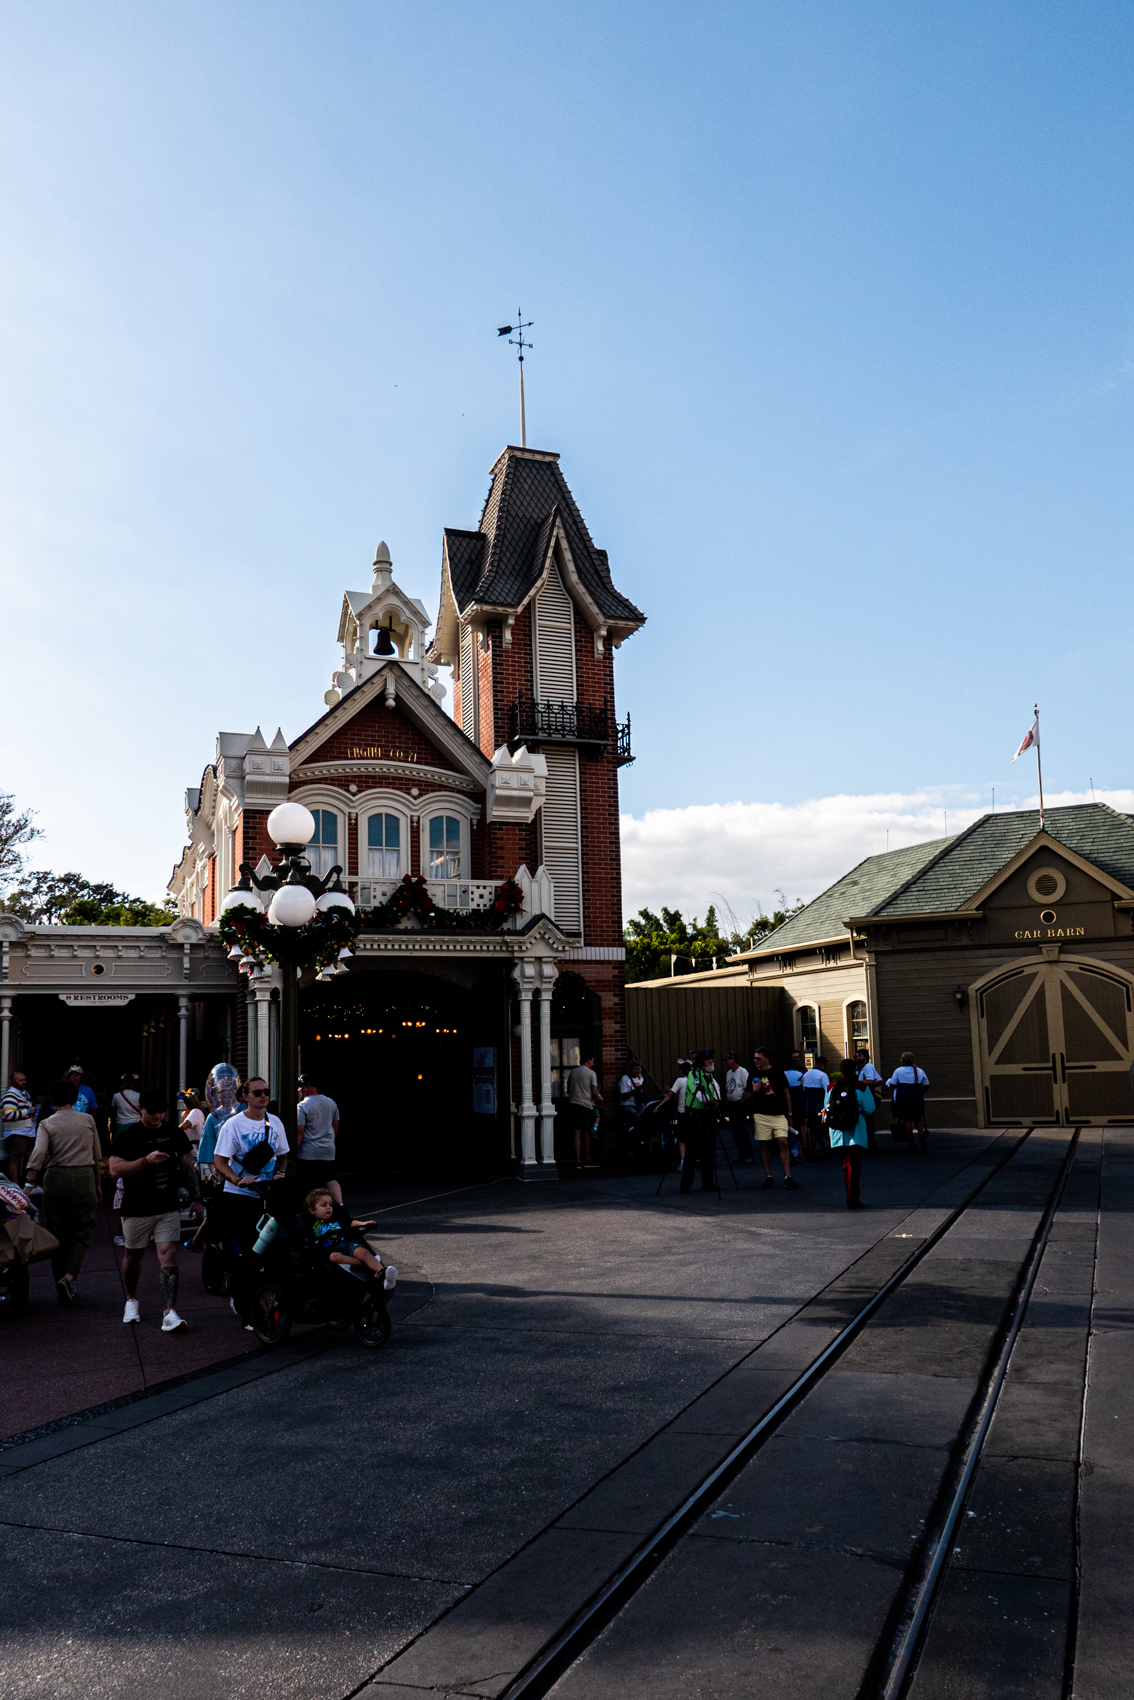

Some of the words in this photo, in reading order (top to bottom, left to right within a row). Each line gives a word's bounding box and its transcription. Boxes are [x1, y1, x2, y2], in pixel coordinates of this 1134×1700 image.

[408, 750, 417, 762] 71
[1014, 930, 1041, 939] CAR
[1047, 927, 1085, 938] BARN
